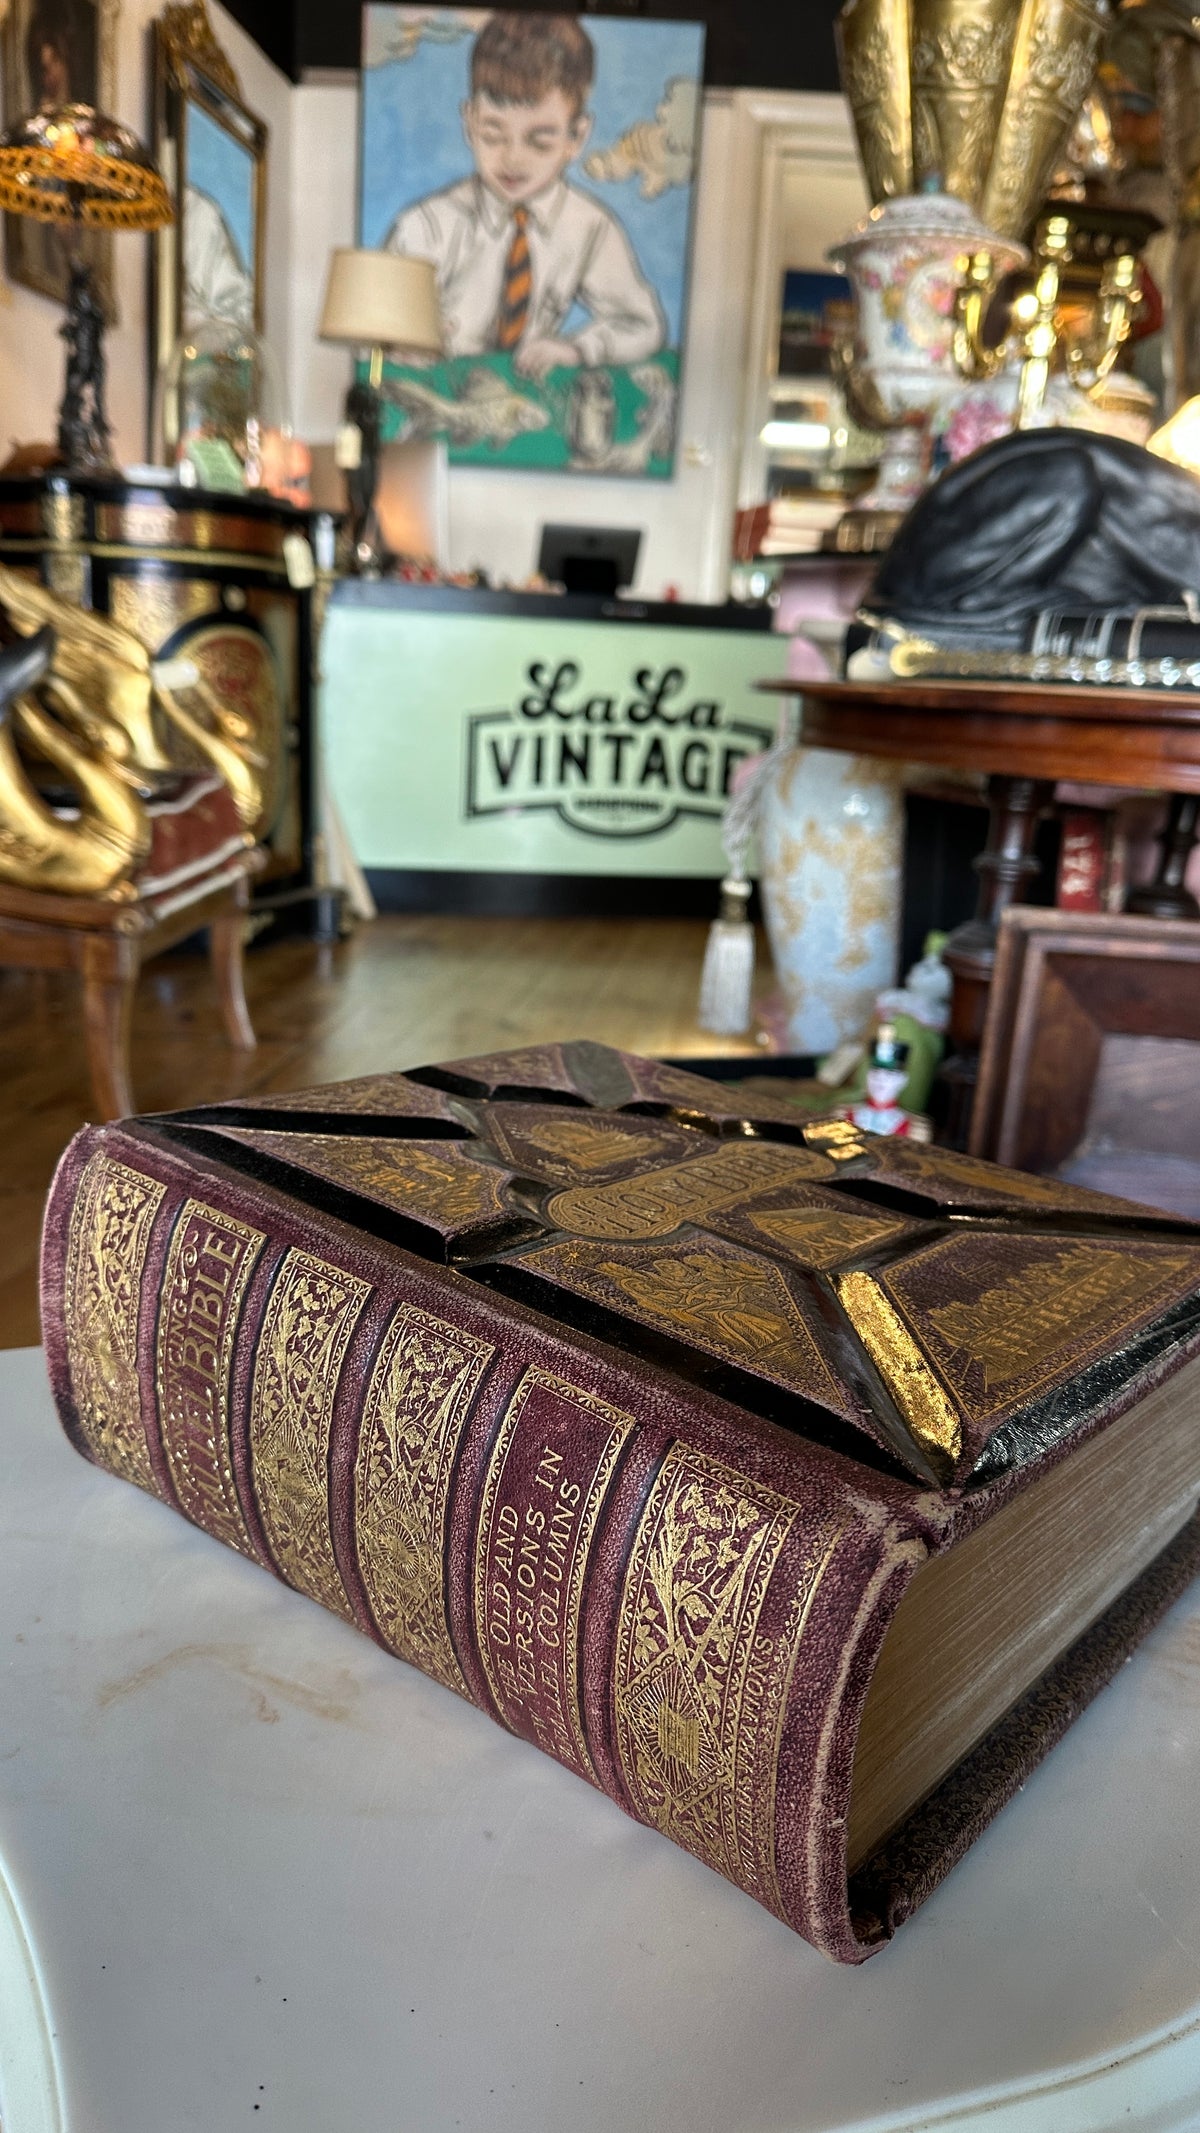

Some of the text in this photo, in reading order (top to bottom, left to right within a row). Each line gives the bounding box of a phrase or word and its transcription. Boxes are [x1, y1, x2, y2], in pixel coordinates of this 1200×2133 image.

[183, 1231, 242, 1387] BIBLE
[490, 1504, 524, 1705] THE OLD AND
[515, 1503, 546, 1696] VERSIONS
[534, 1445, 564, 1493] IN
[537, 1478, 581, 1648] COLUMNS
